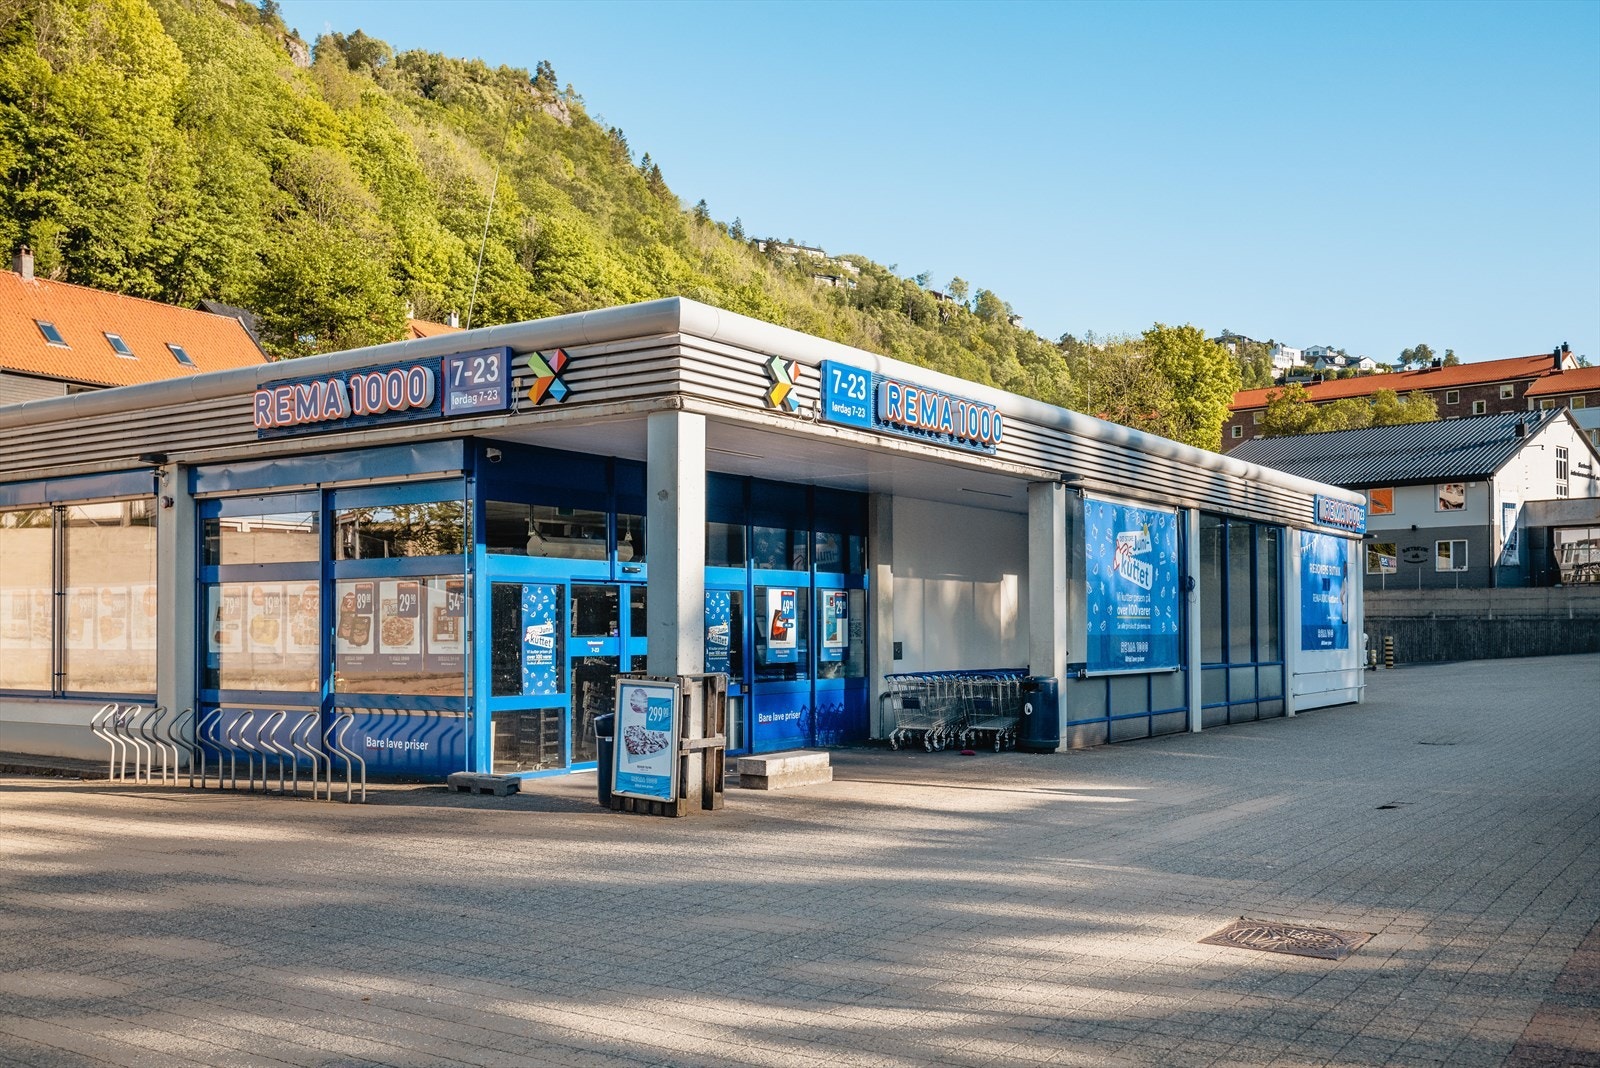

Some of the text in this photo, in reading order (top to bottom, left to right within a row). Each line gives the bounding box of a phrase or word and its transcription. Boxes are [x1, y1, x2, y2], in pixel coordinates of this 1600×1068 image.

[452, 354, 500, 388] 7-23
[832, 369, 867, 401] 7-23
[253, 365, 432, 428] REMA 1000
[451, 389, 499, 408] lørdag 7-23
[831, 401, 866, 419] lørdag 7-23
[887, 381, 1004, 445] REMA 1000
[1121, 554, 1149, 587] kuttet
[357, 593, 366, 609] 89
[399, 594, 410, 612] 29
[448, 592, 460, 610] 54
[782, 600, 789, 615] 49
[530, 633, 552, 648] kuttet
[648, 706, 663, 722] 299
[758, 710, 802, 723] Bare lave priser
[366, 736, 429, 752] Bare lave priser
